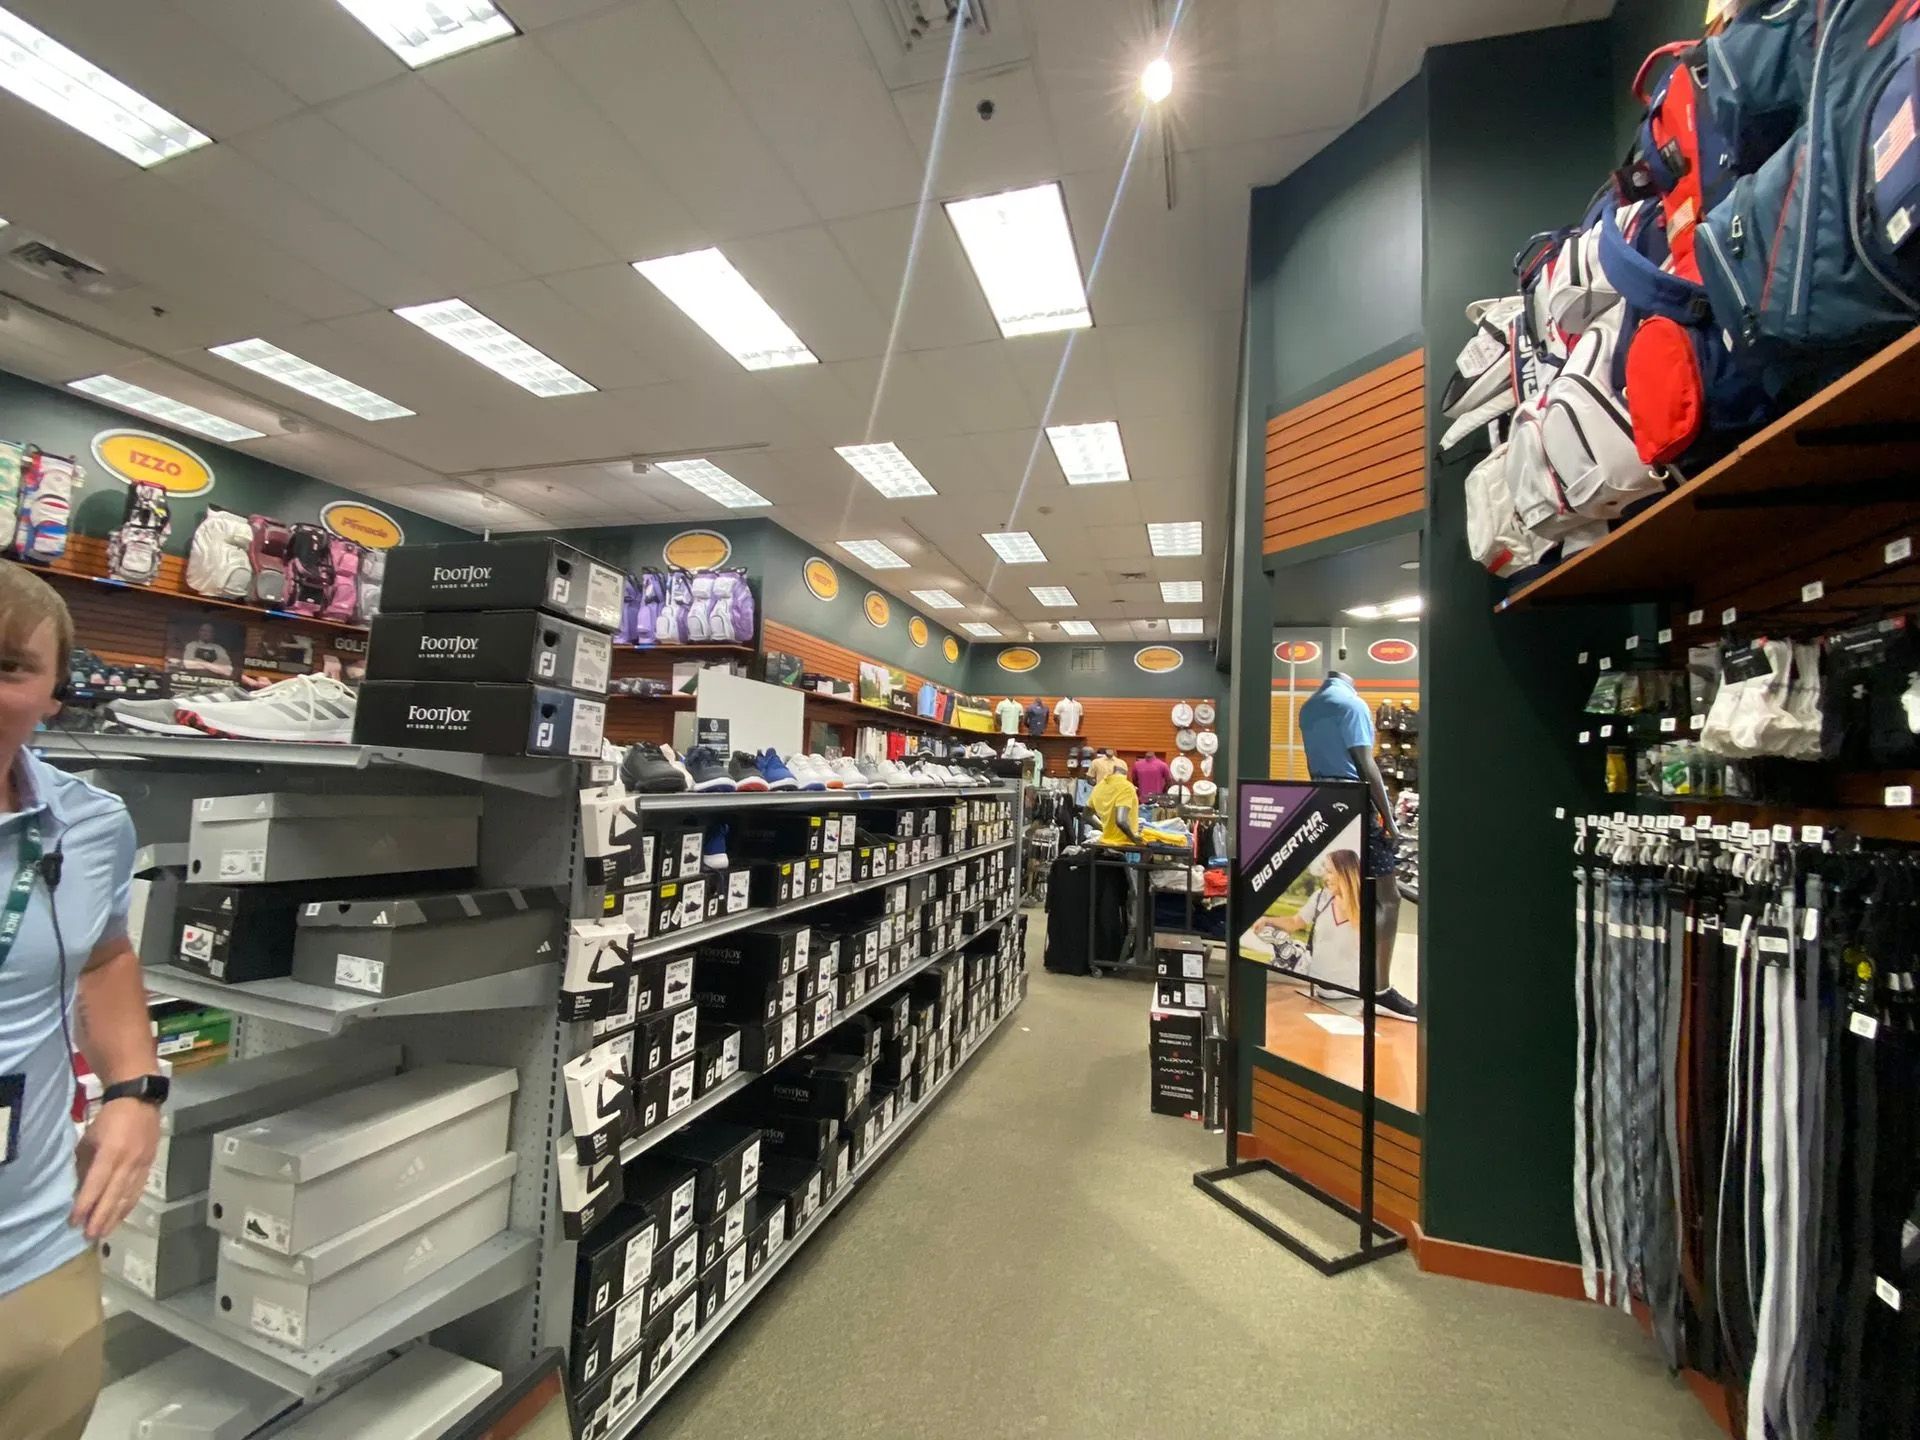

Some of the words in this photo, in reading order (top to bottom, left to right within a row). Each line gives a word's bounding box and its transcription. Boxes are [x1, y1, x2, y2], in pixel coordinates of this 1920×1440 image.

[129, 449, 182, 477] IZZO
[335, 637, 369, 653] GOLF
[244, 657, 278, 669] REPAIR
[1251, 863, 1273, 893] BIG
[1270, 810, 1323, 871] BERTHA
